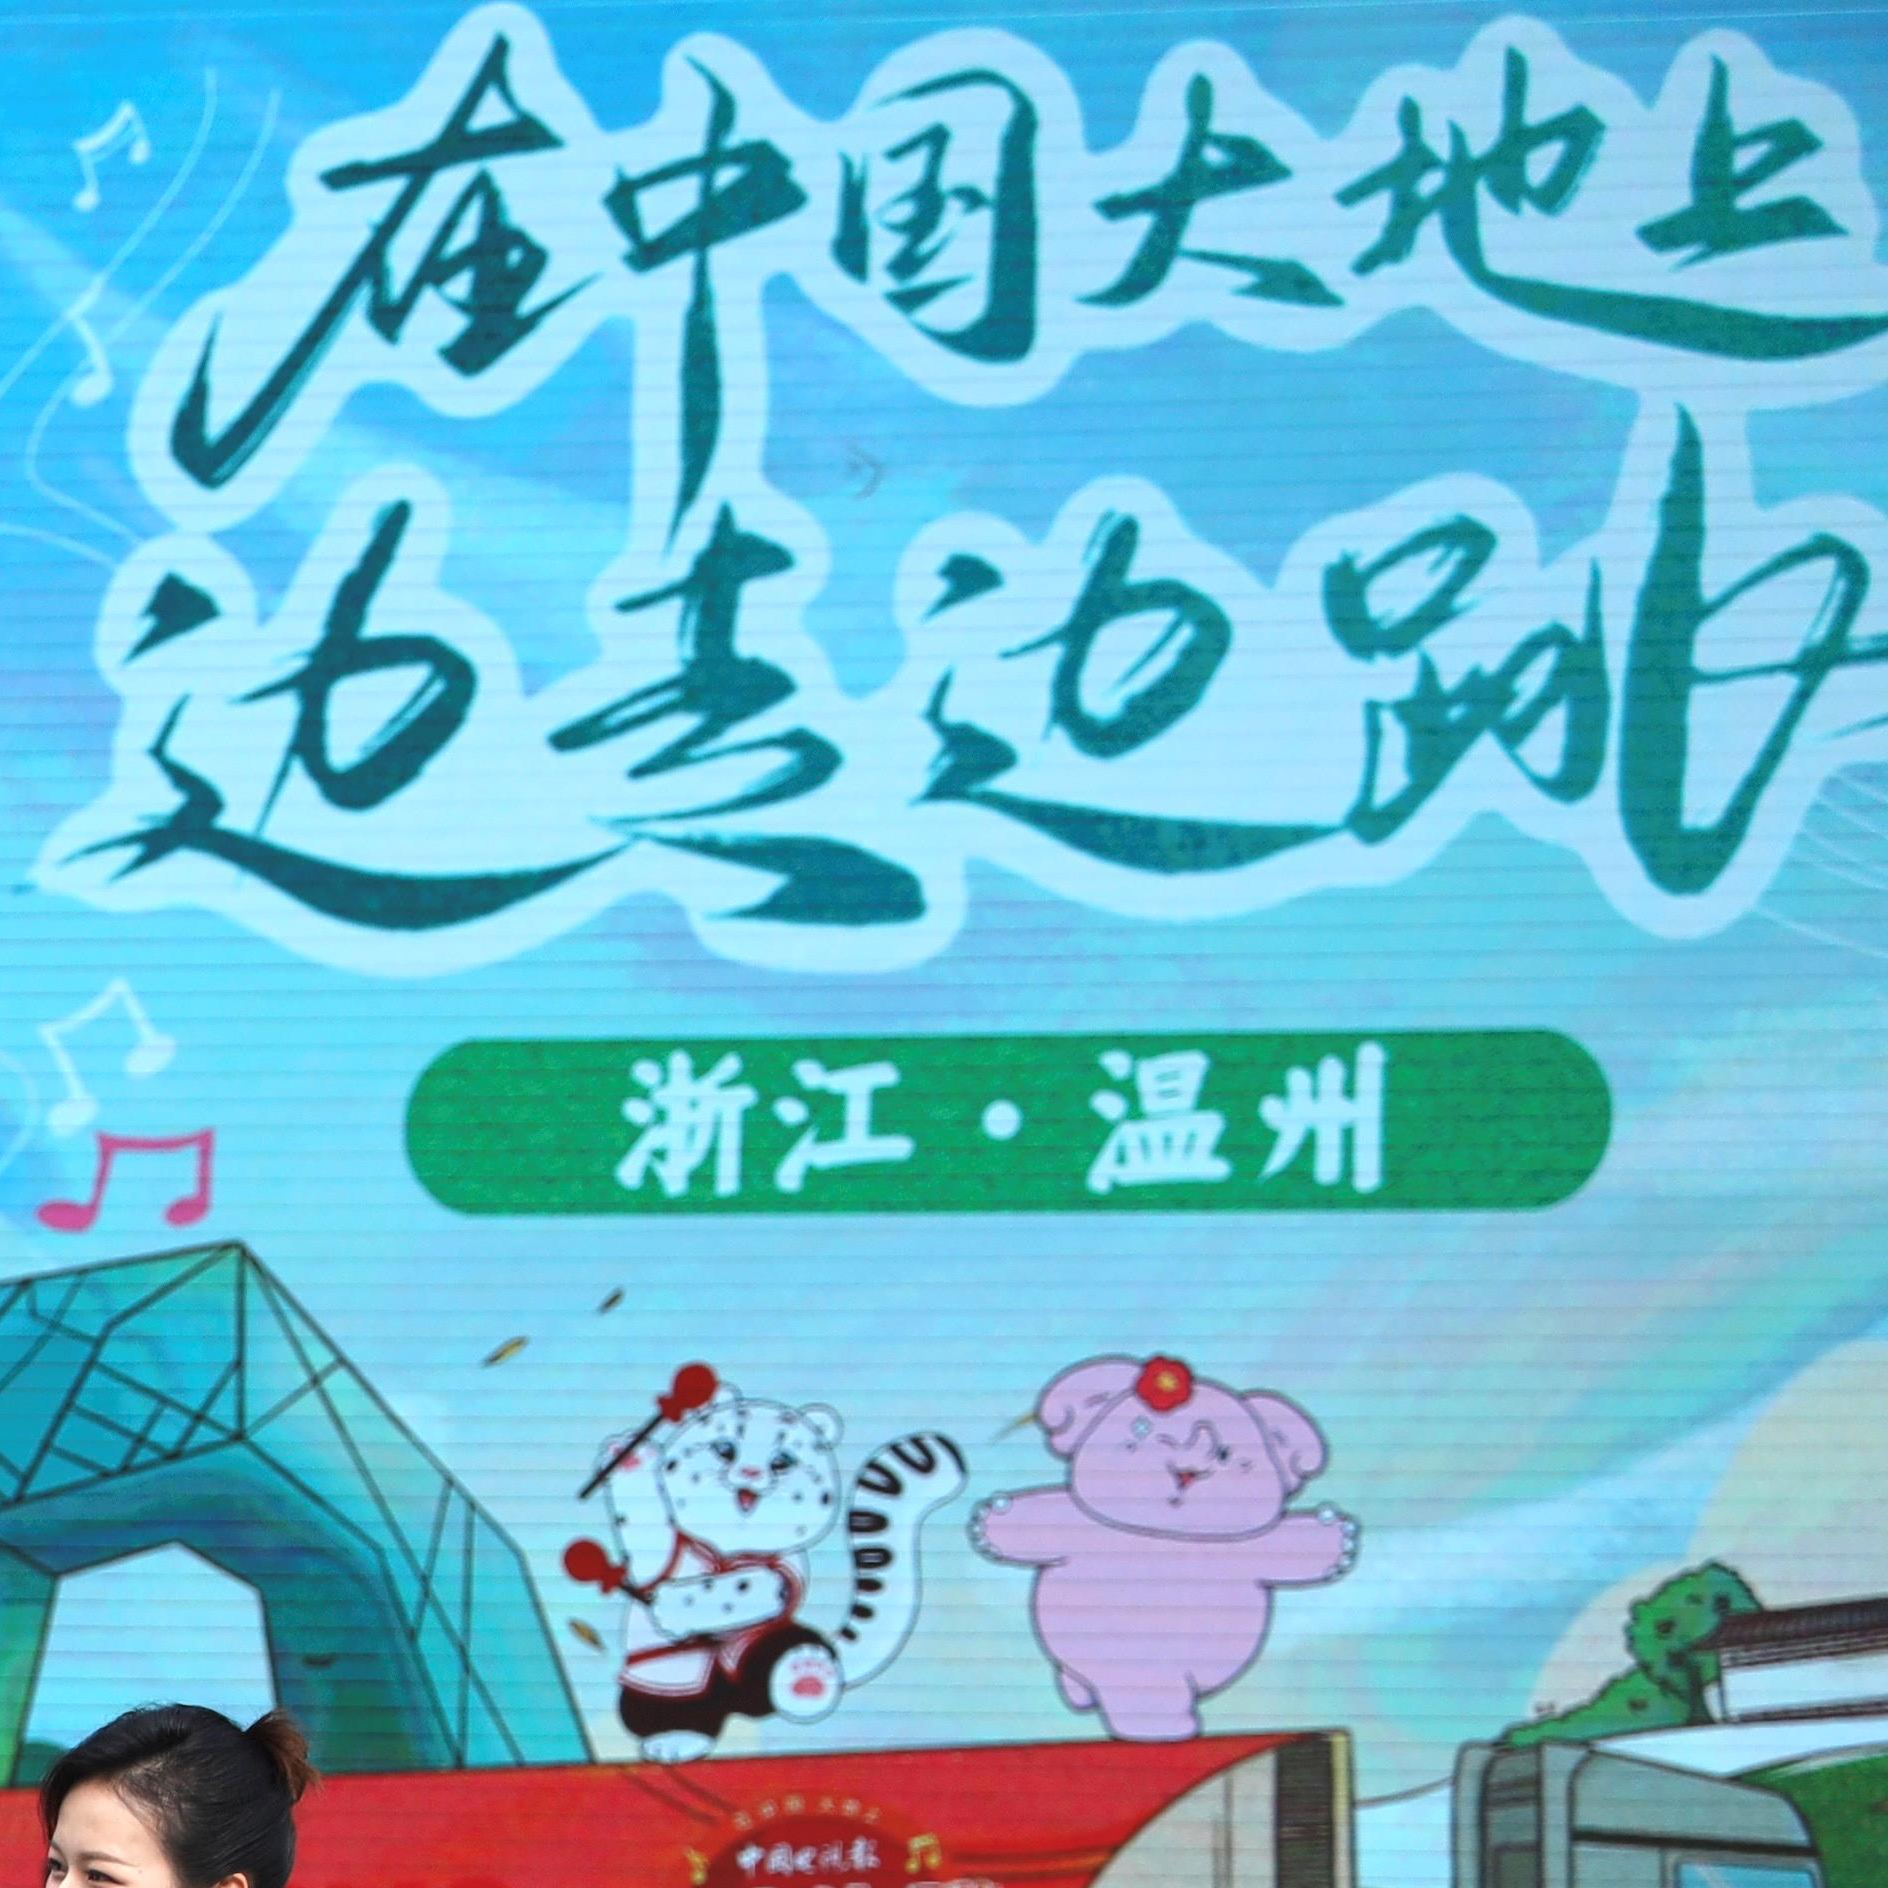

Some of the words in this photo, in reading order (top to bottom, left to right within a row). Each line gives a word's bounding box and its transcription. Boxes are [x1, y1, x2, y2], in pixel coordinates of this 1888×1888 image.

[170, 34, 1888, 533] 在中国大地上
[37, 404, 1888, 932] 边走边跳
